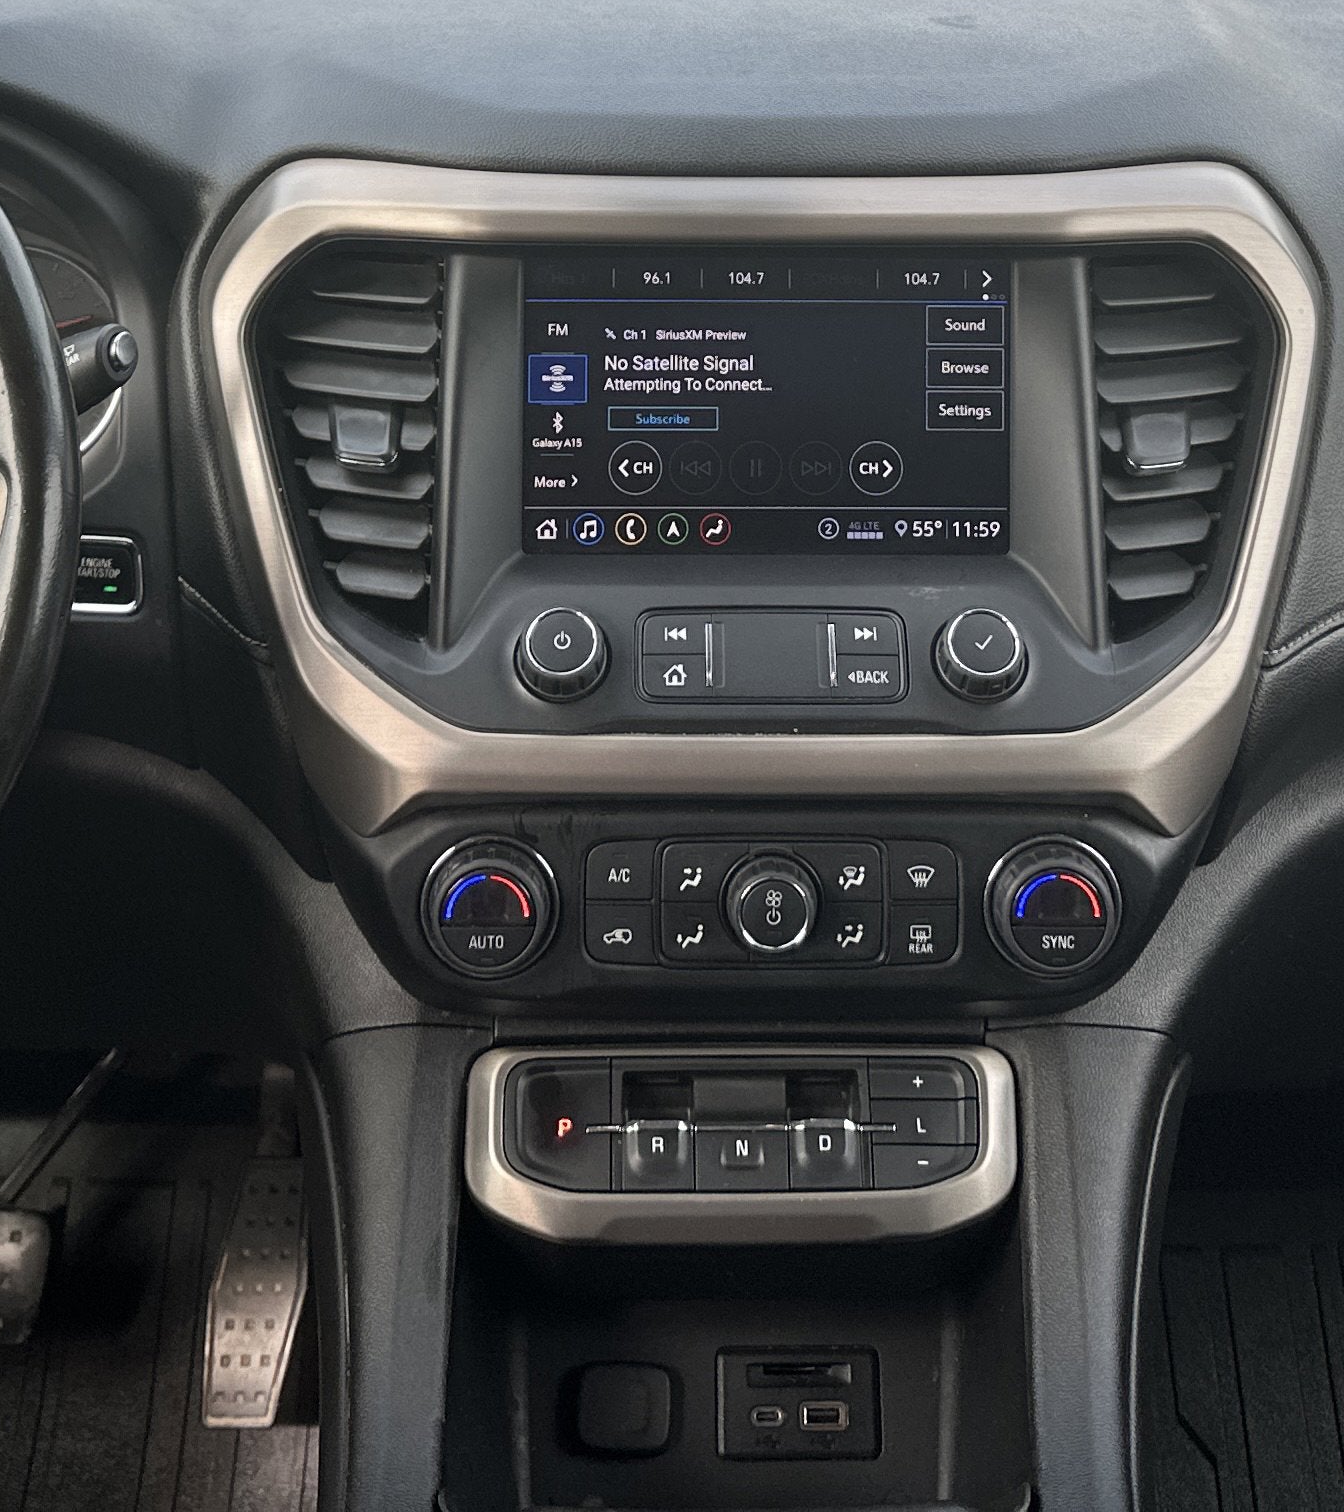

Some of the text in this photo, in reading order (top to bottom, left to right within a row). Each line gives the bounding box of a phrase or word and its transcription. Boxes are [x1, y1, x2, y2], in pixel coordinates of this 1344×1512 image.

[643, 271, 671, 285] 96.1
[728, 271, 765, 285] 104.7
[903, 271, 940, 285] 104.7
[547, 323, 569, 337] FM
[944, 318, 986, 332] Sound
[623, 329, 638, 341] Ch
[656, 329, 703, 341] SiriusXM
[705, 329, 747, 341] Preview
[604, 355, 755, 375] No Satellite Signal
[941, 361, 990, 375] Browse
[603, 376, 681, 395] Attempting
[684, 377, 702, 392] To
[635, 412, 691, 425] Subscribe
[938, 403, 992, 420] Settings
[532, 437, 583, 450] Galaxy A15
[633, 461, 654, 475] CH
[859, 461, 880, 475] CH
[534, 476, 566, 488] More
[824, 523, 833, 534] 2
[863, 521, 880, 530] LTE
[952, 521, 1001, 538] 11:59
[80, 556, 113, 568] ENGINE
[77, 567, 121, 579] TART/STOP
[856, 669, 889, 685] BACK
[608, 866, 631, 884] A/C
[468, 933, 504, 950] AUTO
[908, 941, 934, 954] REAR
[1042, 933, 1075, 951] SYNC
[557, 1118, 572, 1137] P
[915, 1117, 927, 1134] L
[651, 1136, 664, 1153] R
[736, 1140, 749, 1156] N
[819, 1134, 832, 1151] D
